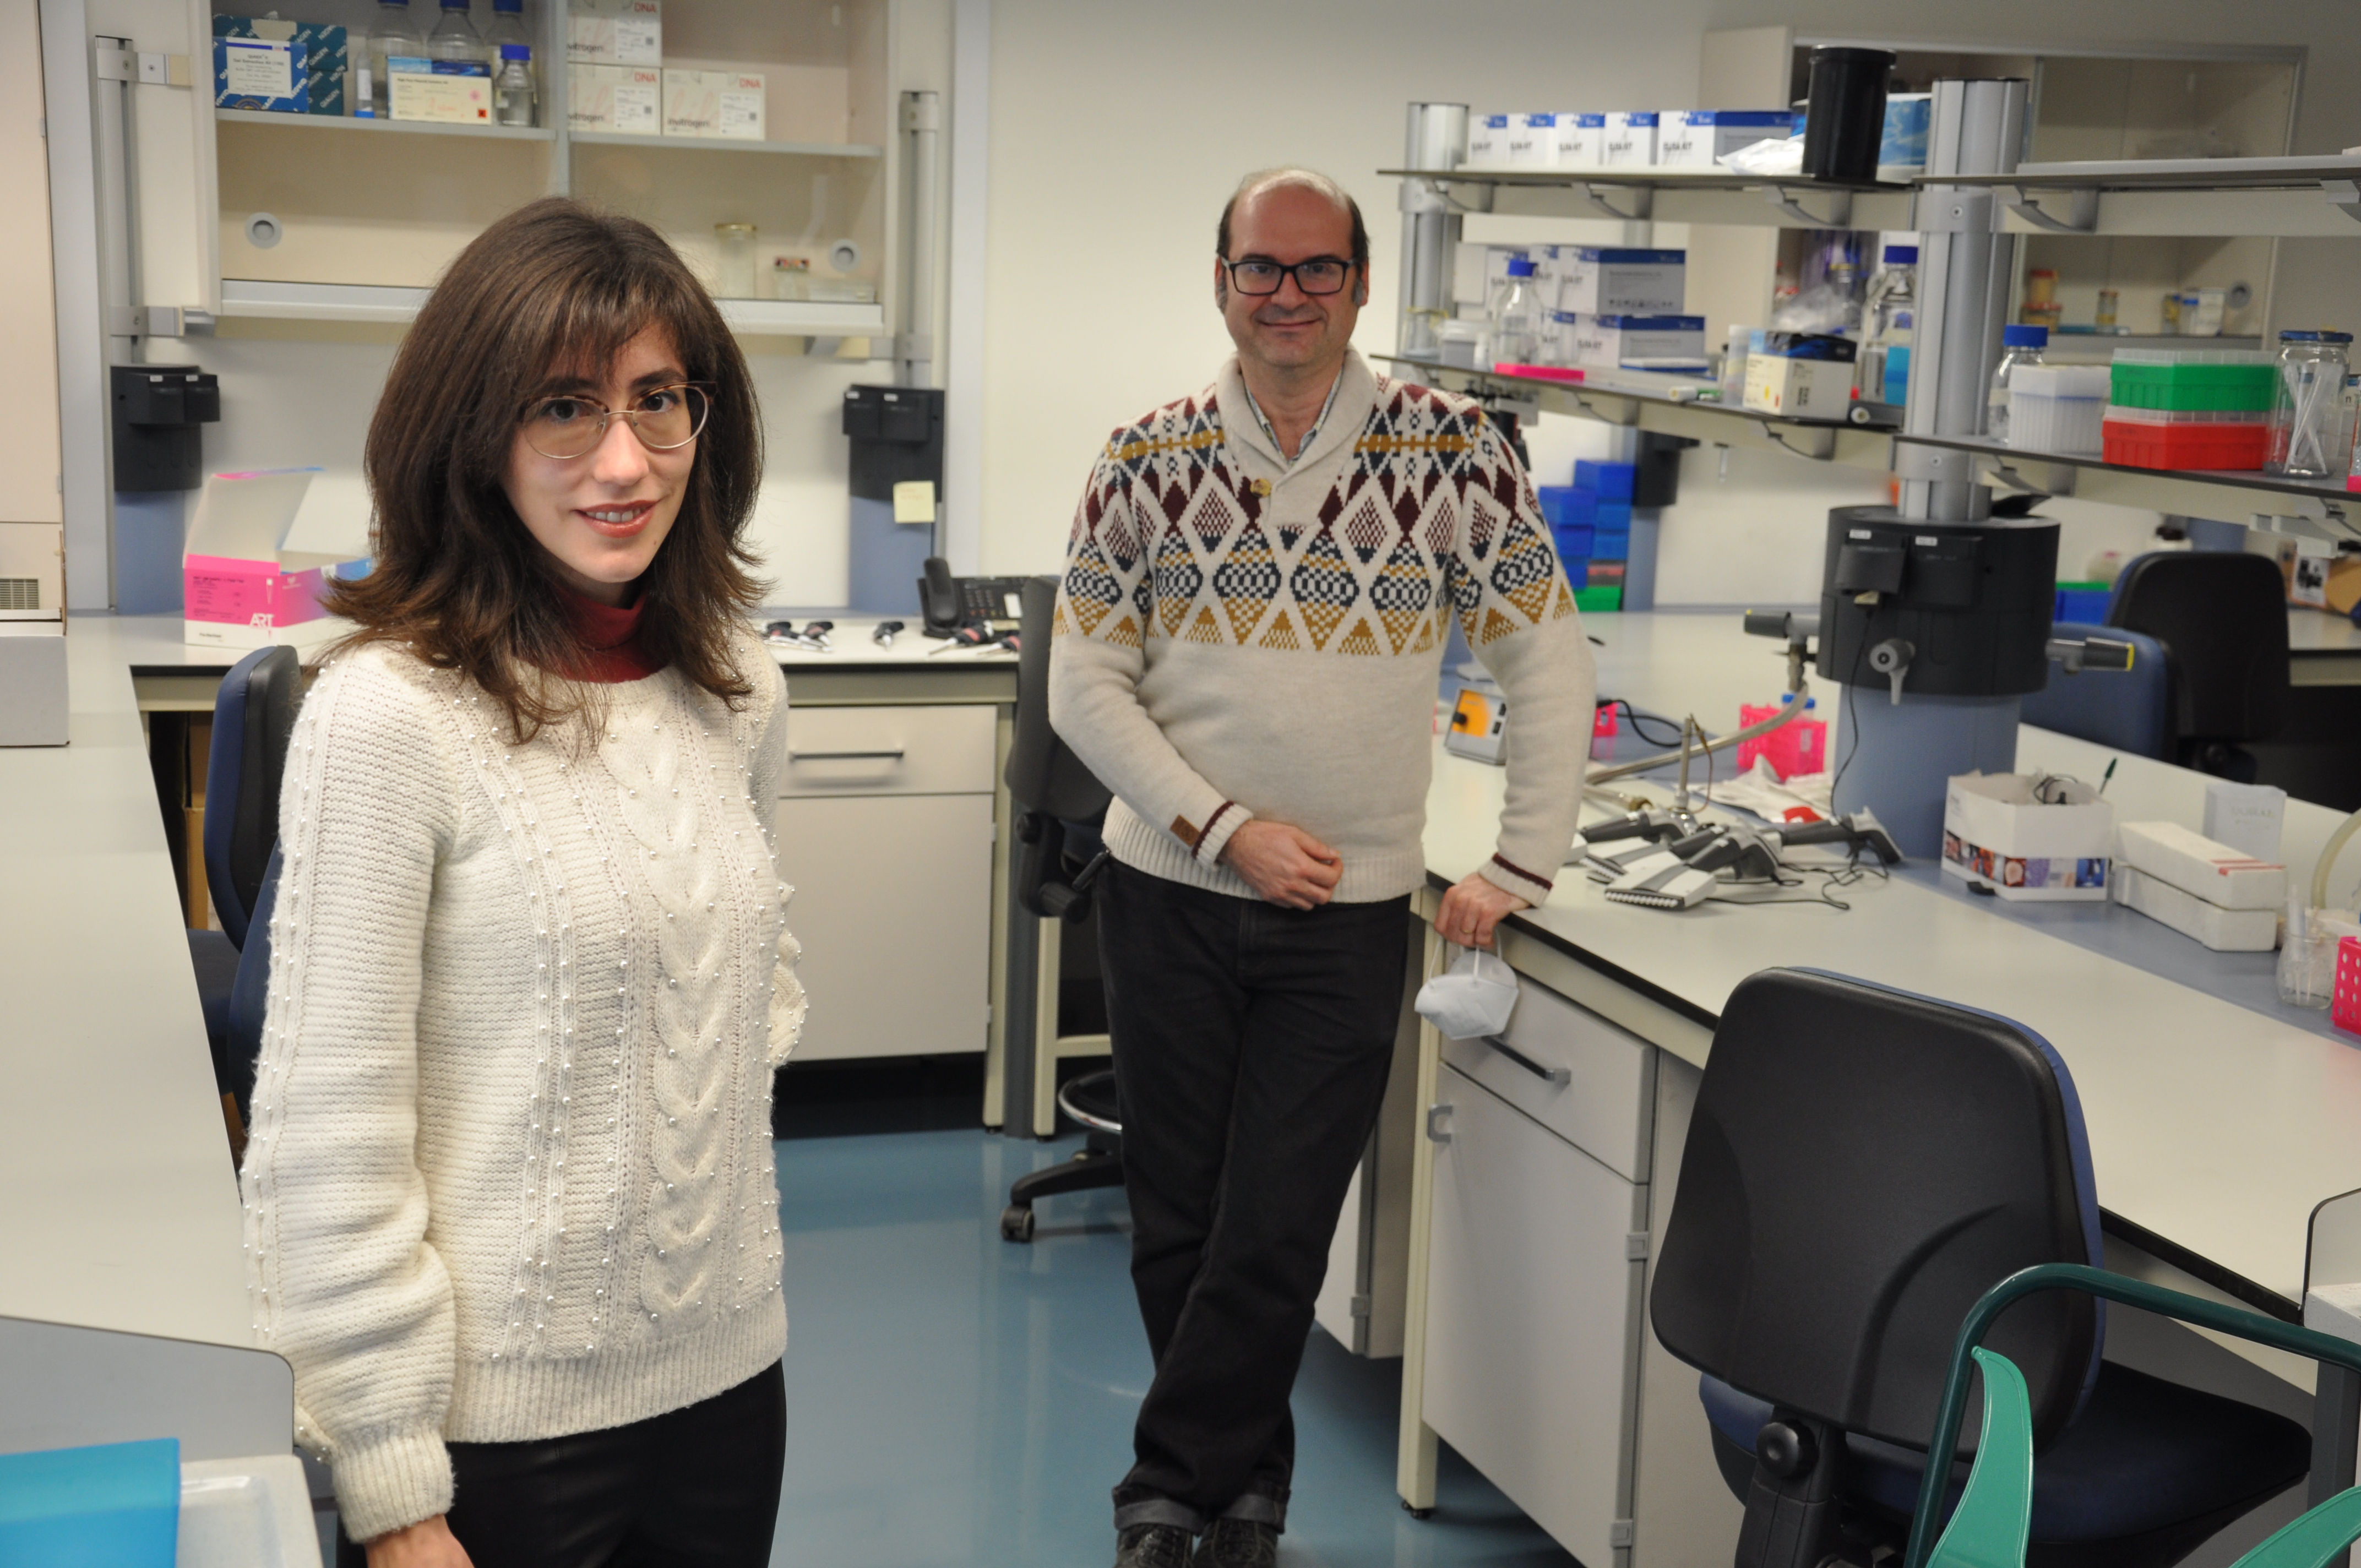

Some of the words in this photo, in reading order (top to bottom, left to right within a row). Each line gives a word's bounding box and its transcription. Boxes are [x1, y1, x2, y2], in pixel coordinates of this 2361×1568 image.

[634, 2, 657, 13] DNA
[567, 43, 603, 52] vitrogen
[634, 72, 657, 82] DNA
[739, 78, 761, 89] DNA
[567, 113, 604, 122] vitrogen
[667, 119, 710, 129] invitrogen
[249, 613, 274, 628] ART
